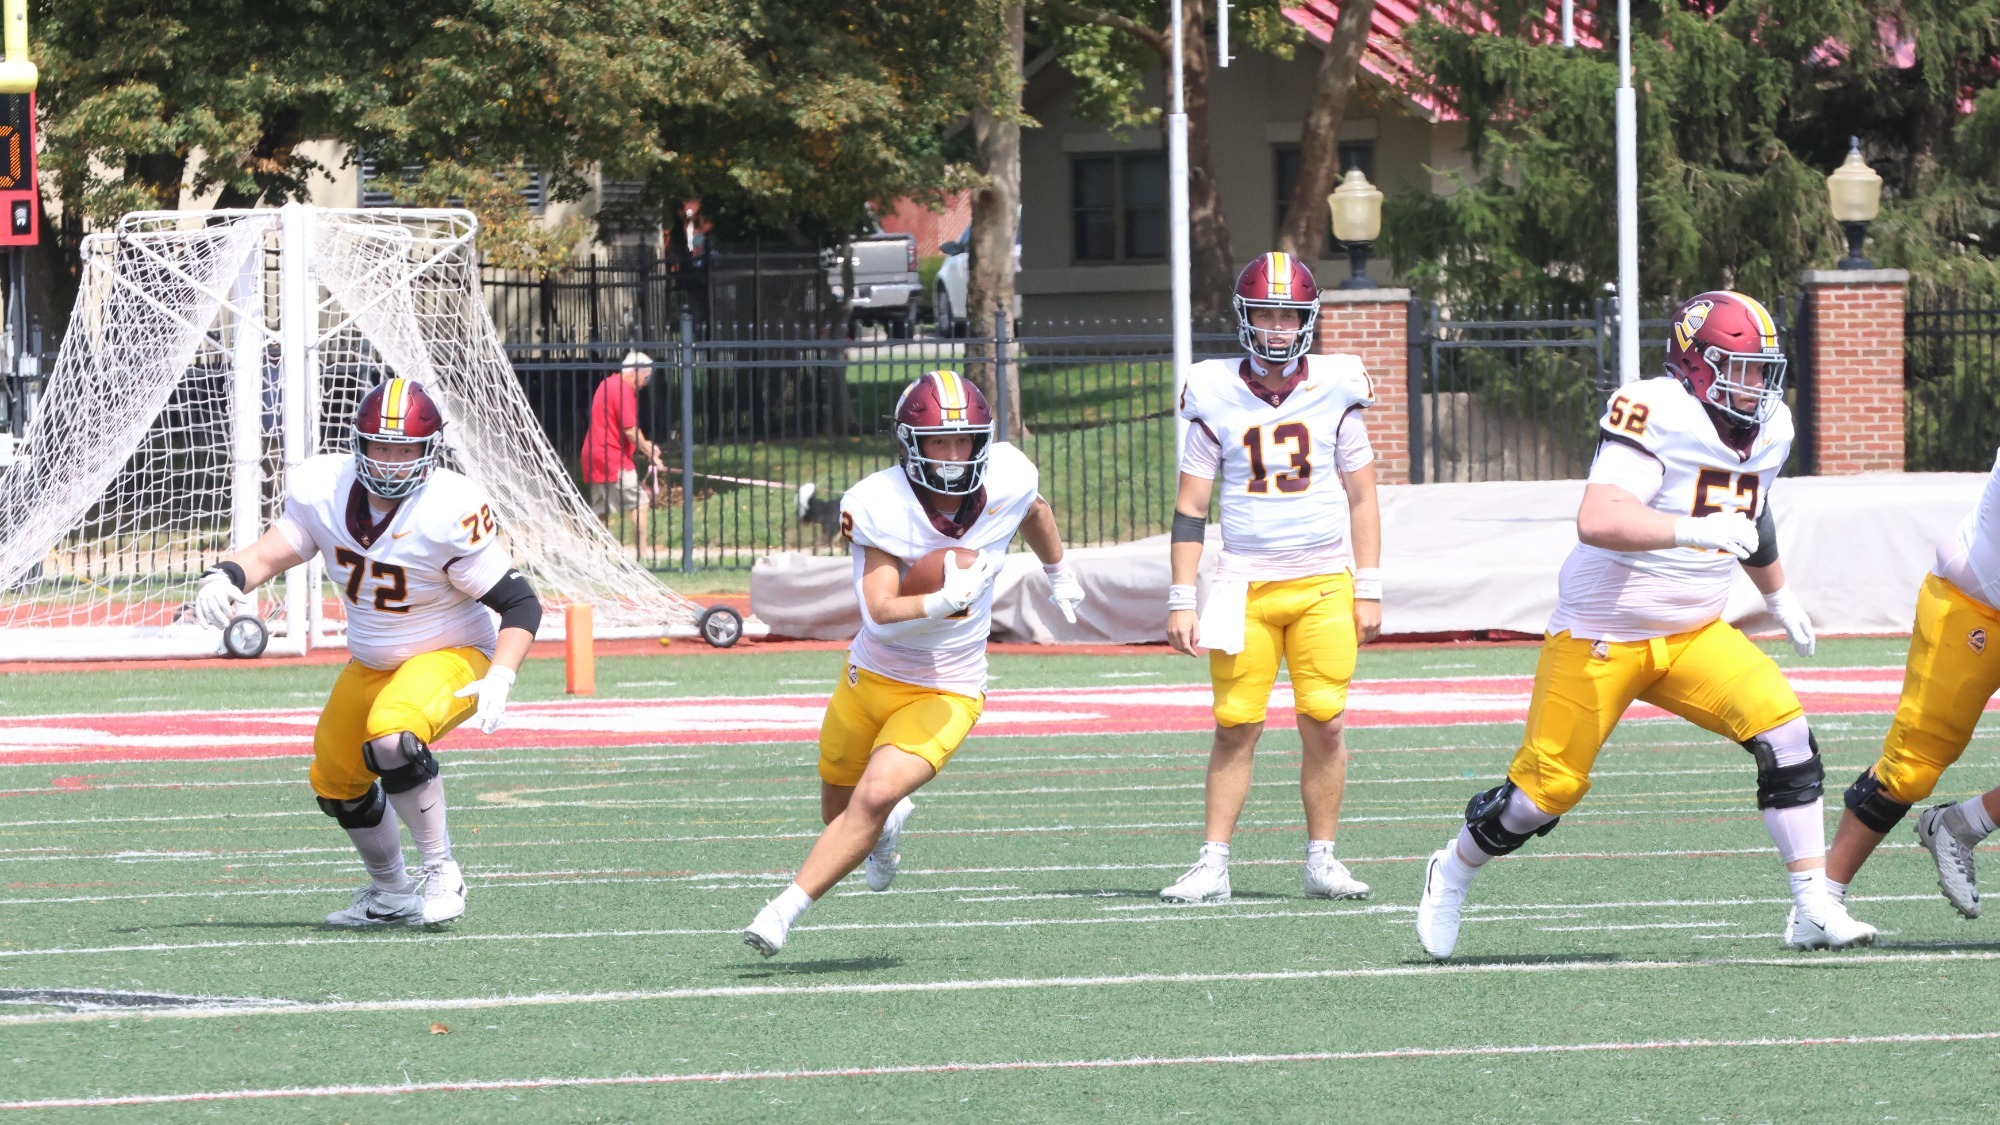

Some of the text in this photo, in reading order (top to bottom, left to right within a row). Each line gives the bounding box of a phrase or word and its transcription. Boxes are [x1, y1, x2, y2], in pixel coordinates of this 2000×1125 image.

[1609, 395, 1650, 437] 52
[1242, 420, 1312, 494] 13
[462, 503, 494, 544] 72
[841, 510, 854, 542] 2
[333, 545, 410, 615] 72
